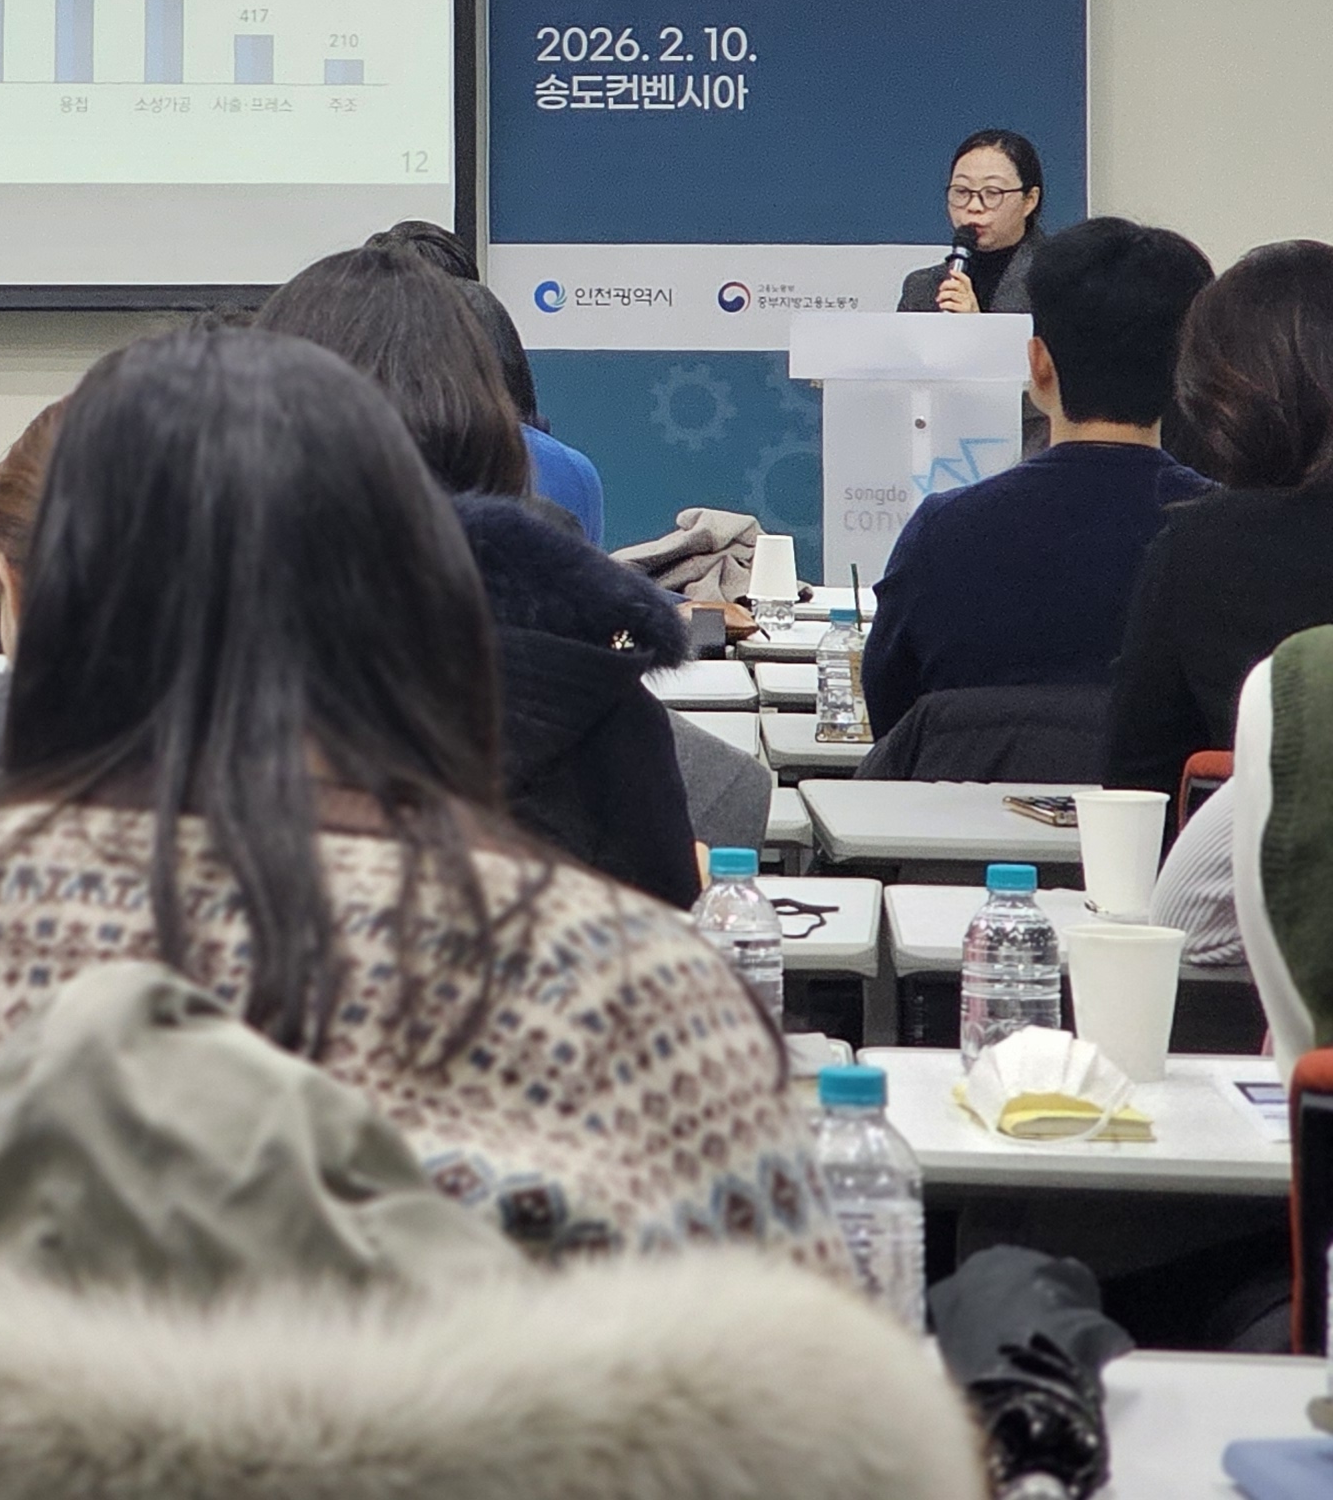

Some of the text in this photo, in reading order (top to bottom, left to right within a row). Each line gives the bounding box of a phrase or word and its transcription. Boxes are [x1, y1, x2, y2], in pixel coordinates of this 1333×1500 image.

[239, 8, 269, 22] 417
[329, 33, 359, 48] 210
[537, 27, 757, 62] 2026. 2. 10.
[535, 74, 748, 110] 송도컨벤시아
[402, 151, 428, 173] 12
[575, 288, 672, 306] 인천광역시
[844, 485, 907, 506] songdo
